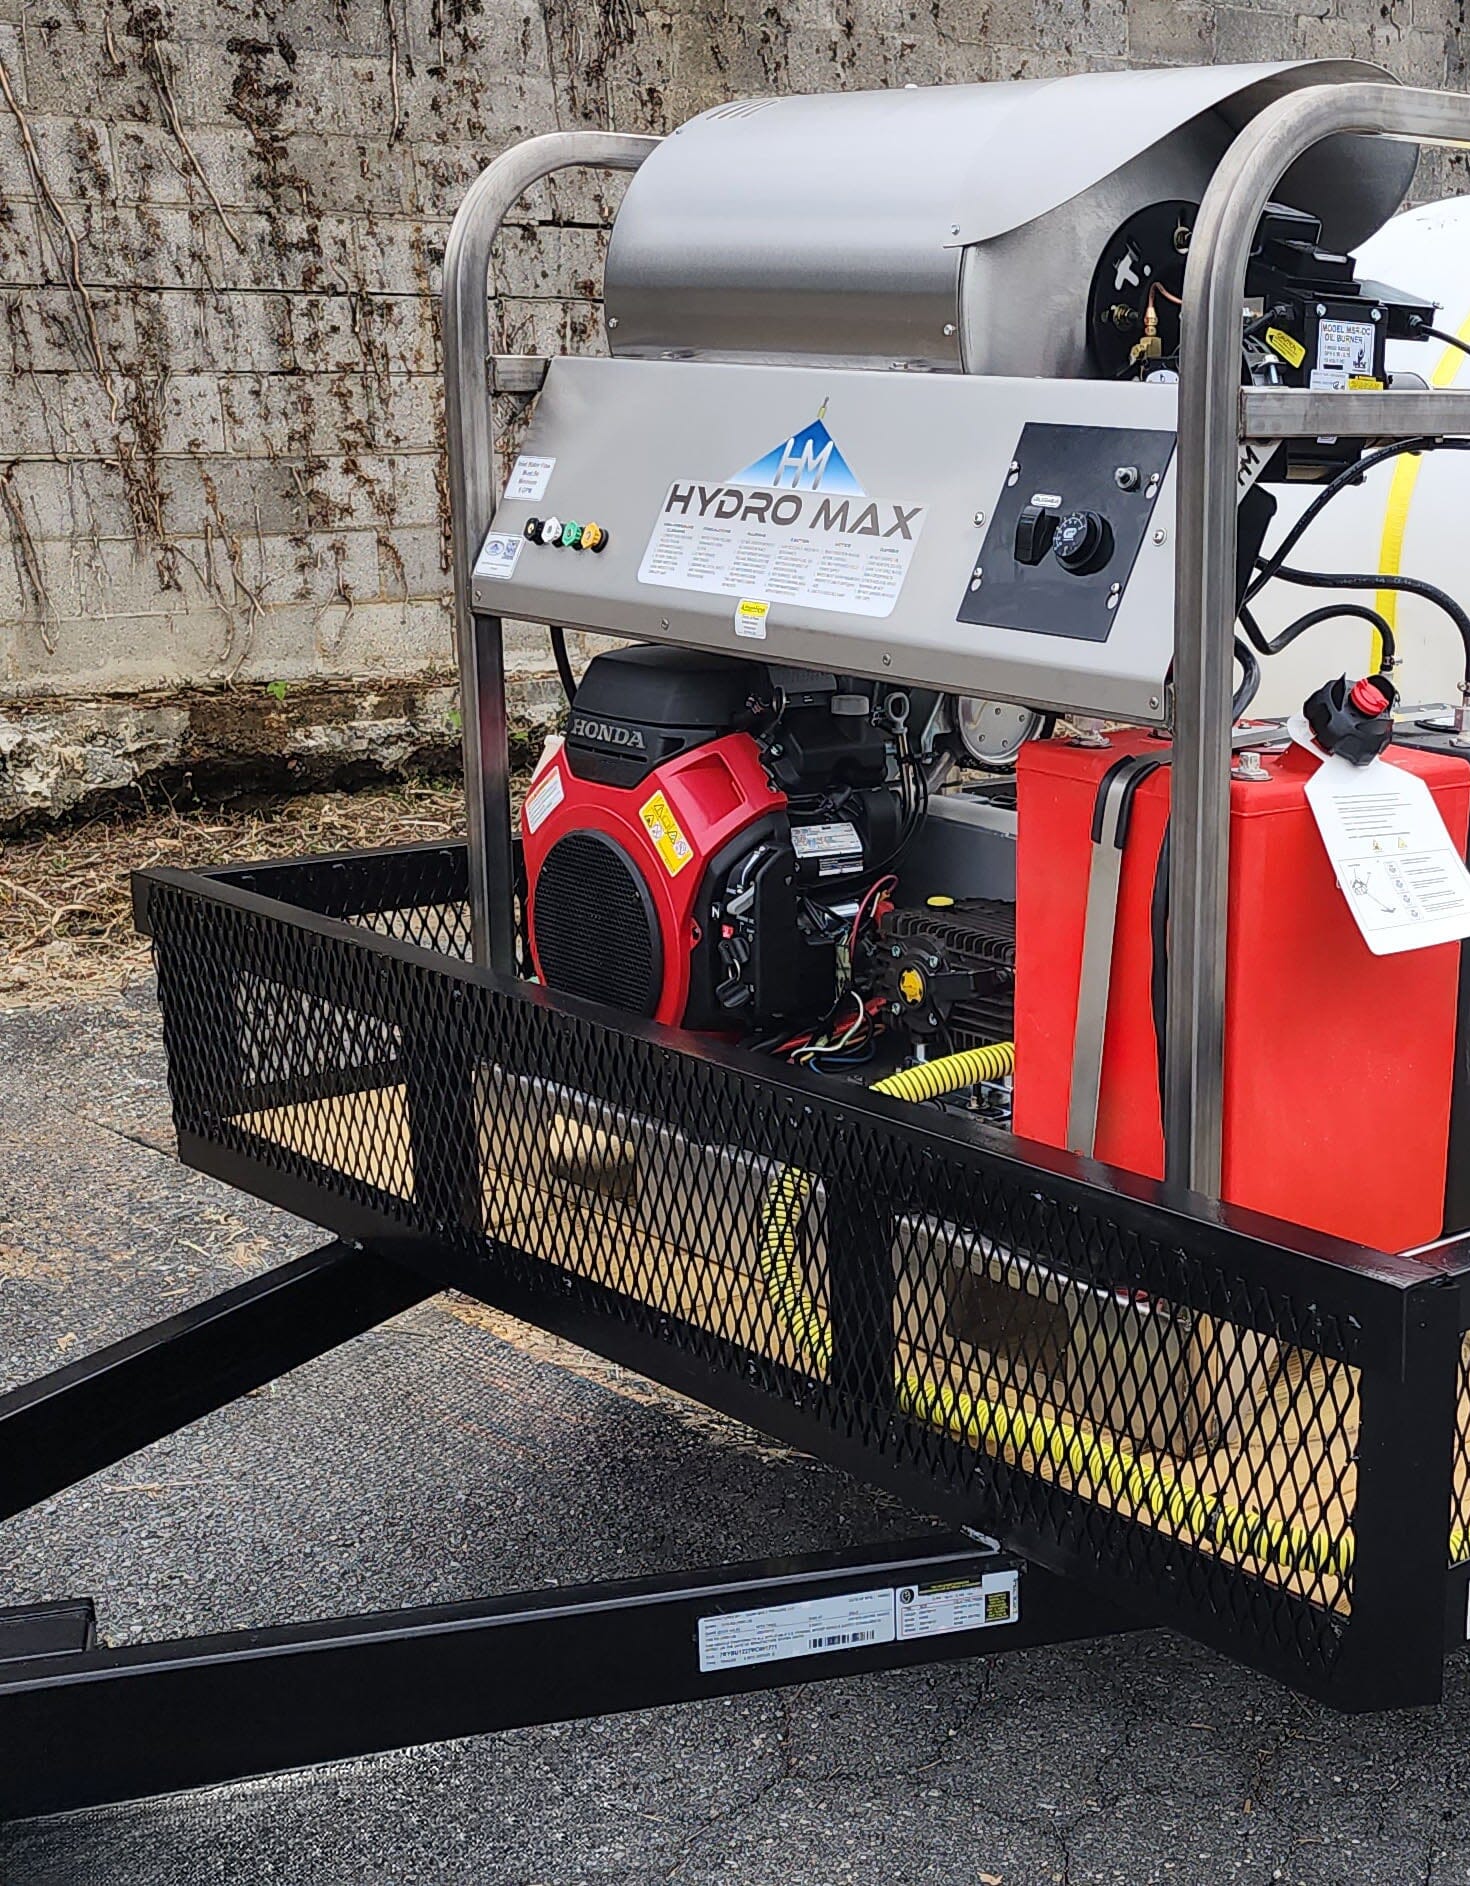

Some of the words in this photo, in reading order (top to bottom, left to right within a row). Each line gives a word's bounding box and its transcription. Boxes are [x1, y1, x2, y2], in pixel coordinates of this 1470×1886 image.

[772, 436, 834, 490] HM
[664, 482, 803, 526] HYDRO
[808, 497, 924, 541] MAX
[570, 718, 646, 749] HONDA
